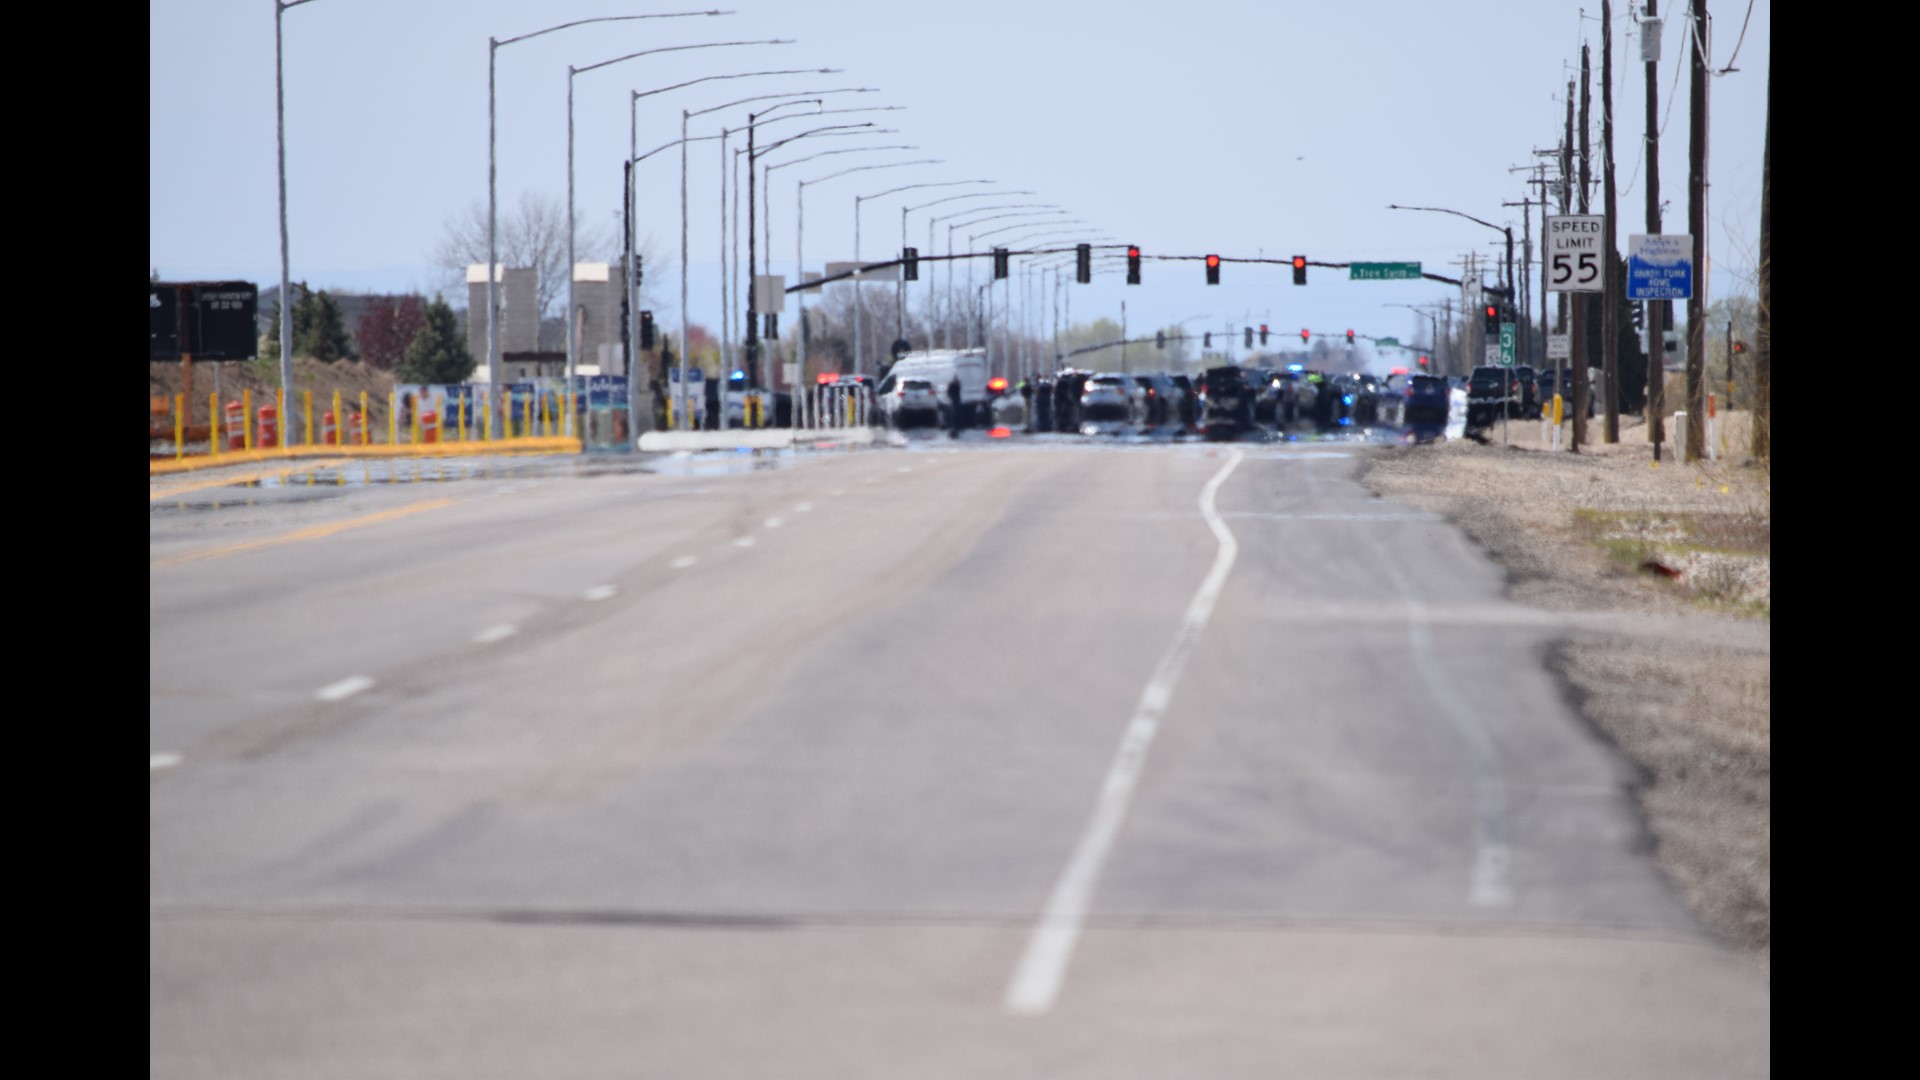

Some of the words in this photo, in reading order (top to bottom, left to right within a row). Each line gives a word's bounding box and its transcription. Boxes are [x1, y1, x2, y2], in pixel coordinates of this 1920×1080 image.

[1552, 221, 1600, 233] SPEED
[1557, 237, 1595, 249] LIMIT
[1360, 268, 1381, 278] Tree
[1553, 253, 1599, 284] 55
[1636, 287, 1684, 298] INSPECTION
